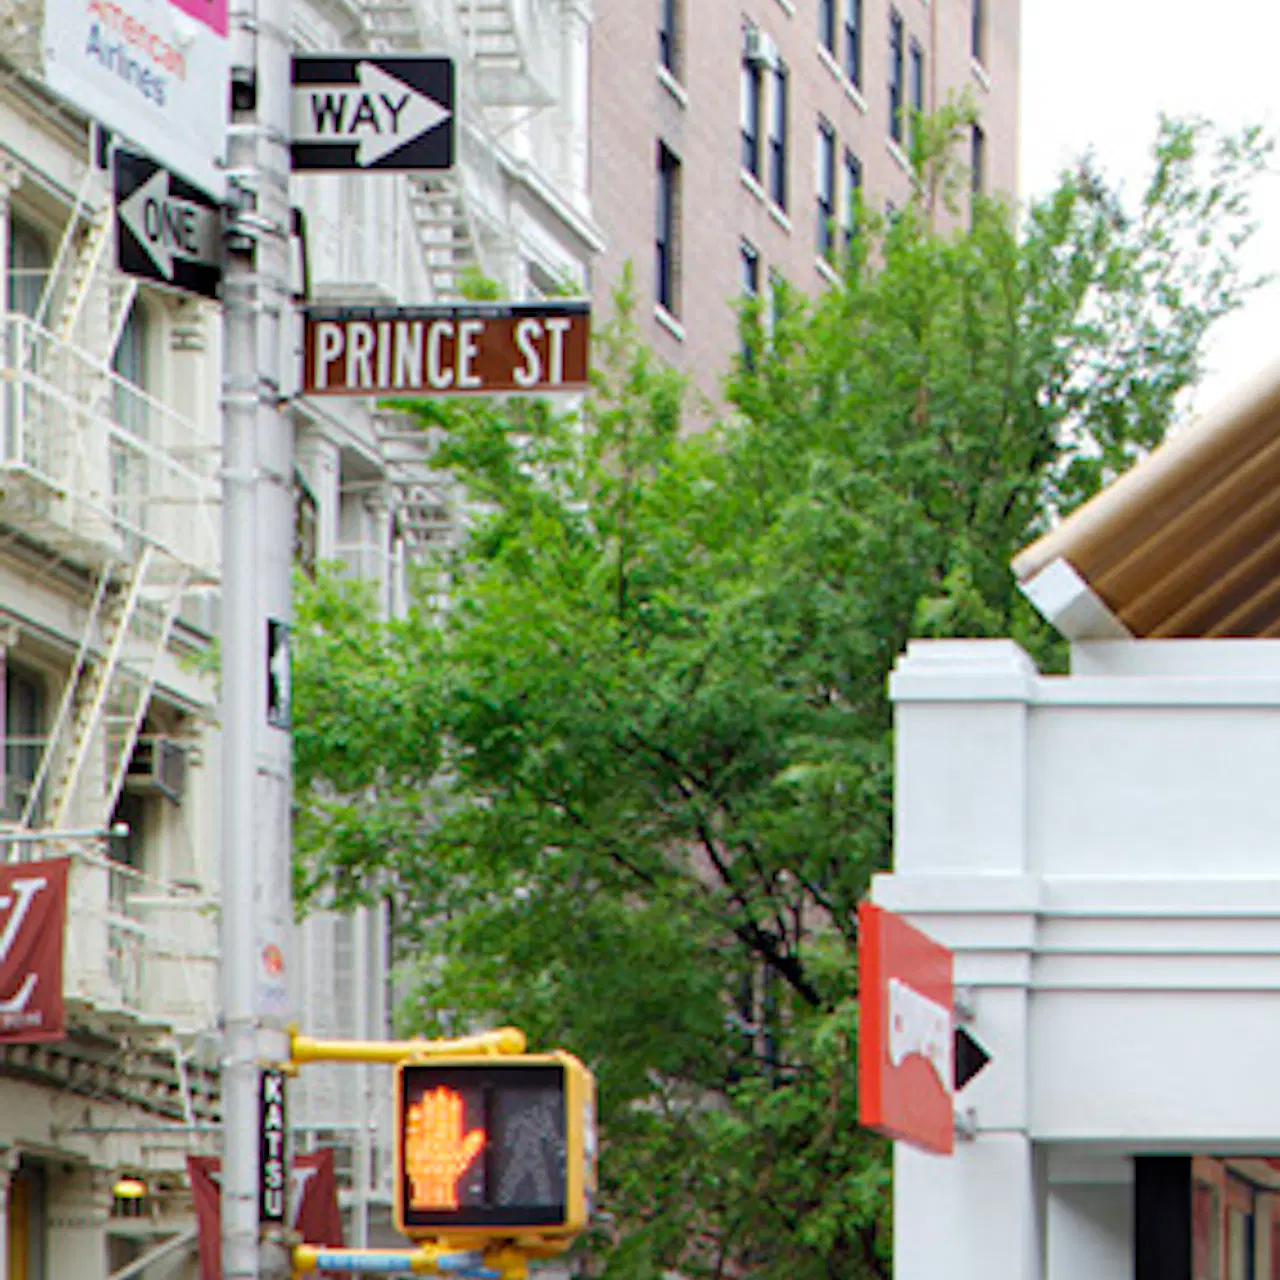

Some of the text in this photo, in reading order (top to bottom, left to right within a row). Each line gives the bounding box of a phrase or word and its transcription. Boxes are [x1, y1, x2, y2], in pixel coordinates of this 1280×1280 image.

[86, 22, 167, 108] Airlines
[311, 93, 410, 135] WAY
[143, 198, 199, 253] ONE
[313, 317, 571, 390] PRINCE ST
[263, 1075, 284, 1218] KATSU
